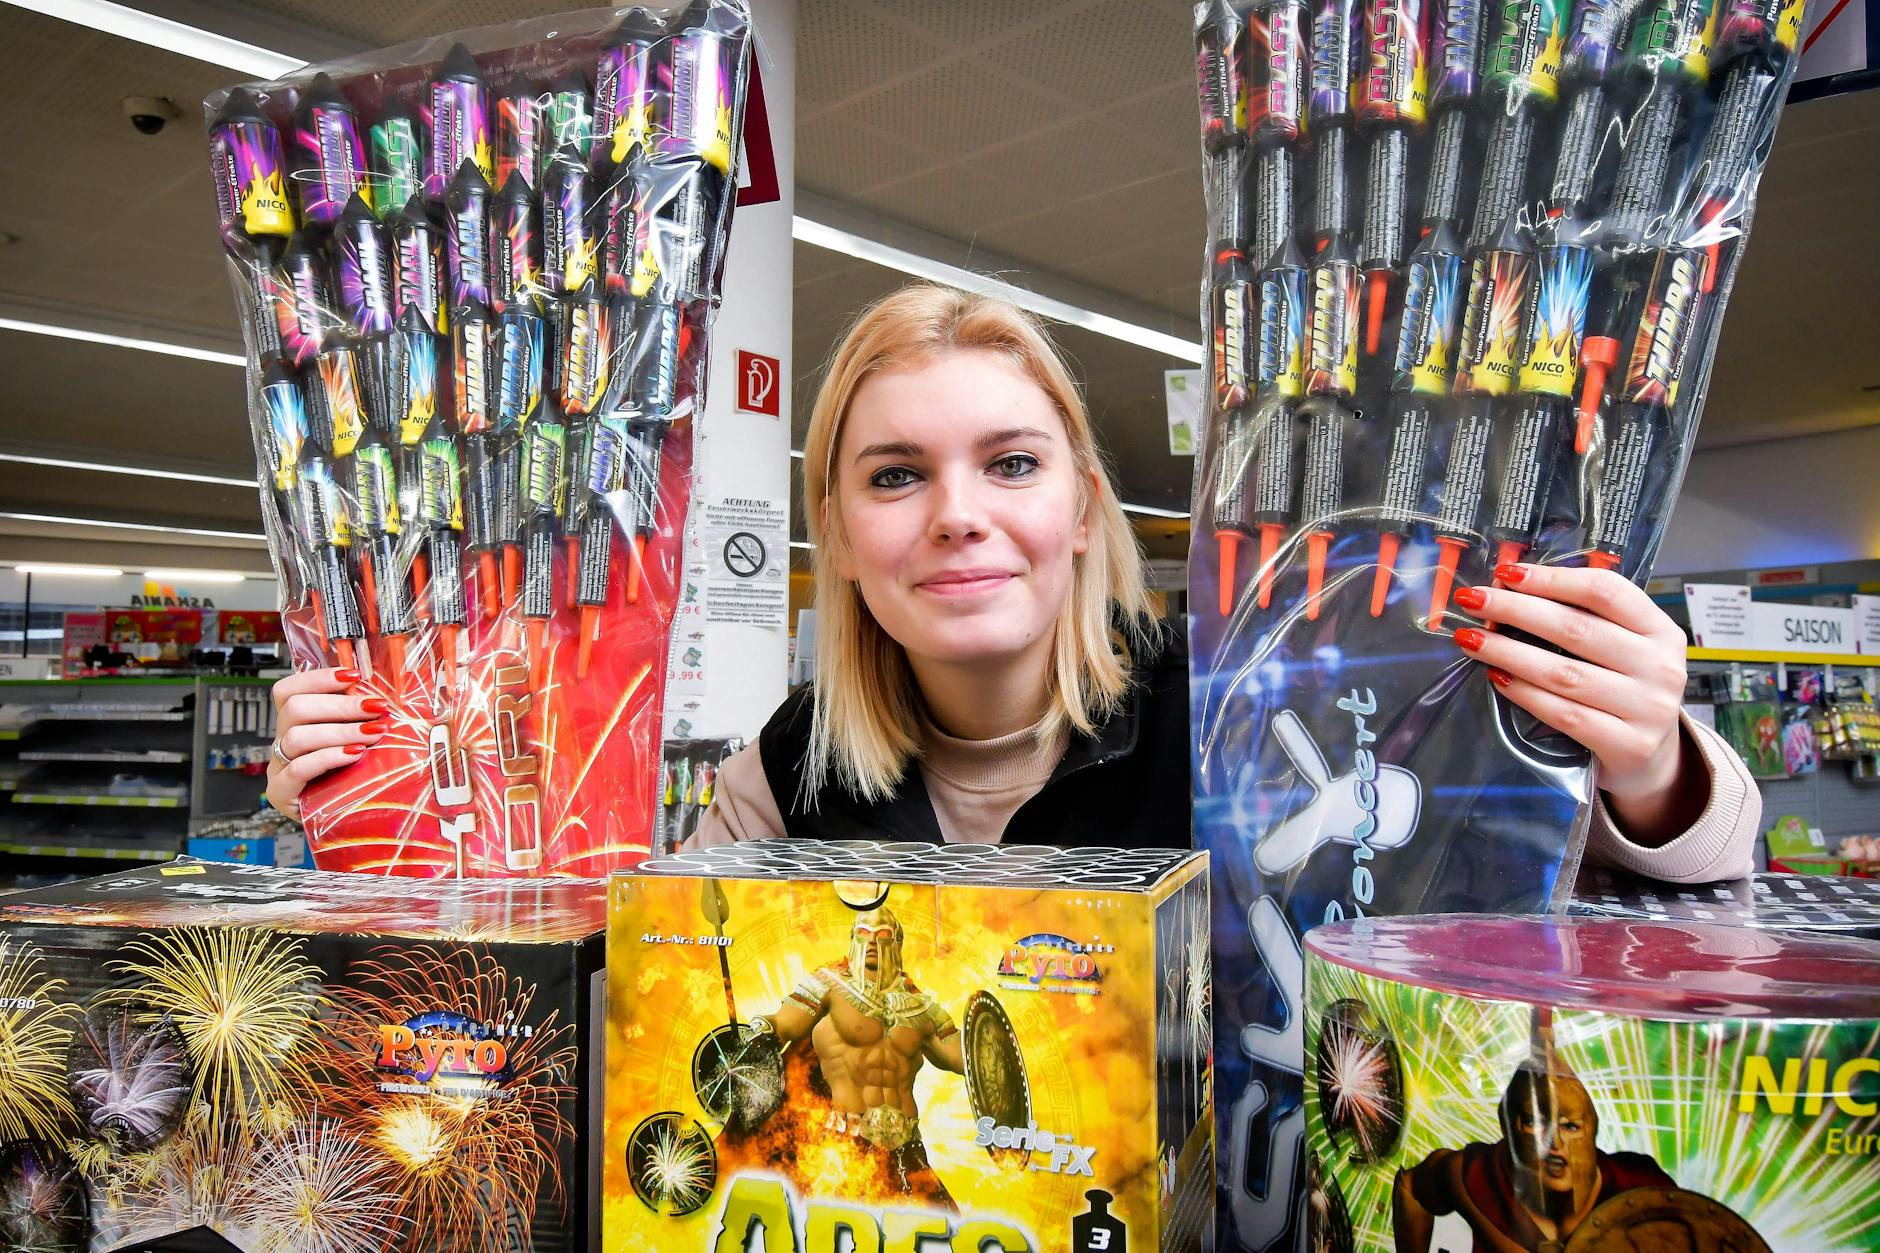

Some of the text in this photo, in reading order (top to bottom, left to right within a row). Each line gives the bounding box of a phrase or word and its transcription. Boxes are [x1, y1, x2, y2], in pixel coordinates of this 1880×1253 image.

[1271, 12, 1294, 114] BLAST
[1312, 15, 1342, 89] FLASH
[1395, 37, 1406, 101] Power-Effekte
[1478, 4, 1489, 76] Power-Effekte
[1495, 0, 1531, 75] BLA
[1523, 4, 1541, 74] Power-Effekte
[608, 76, 618, 139] Power-Effekte
[1219, 57, 1230, 117] Power-Effekte
[1296, 59, 1304, 118] Power-Effekte
[227, 154, 242, 214] Power-Effekte
[344, 140, 358, 193] ower-Effekte
[256, 198, 286, 211] NICO
[399, 238, 425, 307] FLASH
[457, 211, 489, 286] FLASH
[503, 238, 511, 301] Power-Effekte
[556, 209, 565, 271] Power-Effekte
[625, 212, 635, 276] Power-Effekte
[429, 254, 438, 314] Power-Effekte
[1394, 262, 1430, 375] TURBO
[567, 307, 592, 403] TURBO
[1224, 289, 1246, 386] TURBO
[1259, 281, 1281, 385] TURBO
[1279, 300, 1288, 374] Turbo-Power-Effekte
[1311, 269, 1335, 376] TURBO
[1336, 289, 1346, 364] Turbo-Power-Effekte
[1416, 286, 1435, 365] Turbo-Power-Effekte
[1474, 281, 1494, 364] Turbo-Power-Effekte
[1522, 281, 1541, 365] Turbo-Power-Effekte
[1645, 257, 1698, 388] TURBO
[1673, 291, 1701, 380] Turbo-Power-Effekte
[464, 324, 487, 416] TURBO
[499, 322, 524, 420] TURBO
[520, 345, 530, 415] Turbo-Power-Effekte
[1487, 361, 1515, 374] NICO
[1531, 361, 1565, 374] NICO
[338, 430, 360, 440] NICO
[529, 434, 555, 507] BURST
[723, 497, 770, 508] ACHTUNG
[1784, 617, 1842, 644] SAISON
[640, 932, 734, 947] Art.-Nr.: 81101
[1000, 943, 1096, 984] Pyro
[378, 1023, 508, 1084] Pyro
[975, 1116, 1056, 1153] Serie
[1050, 1144, 1098, 1177] FX
[1087, 1227, 1112, 1250] 3
